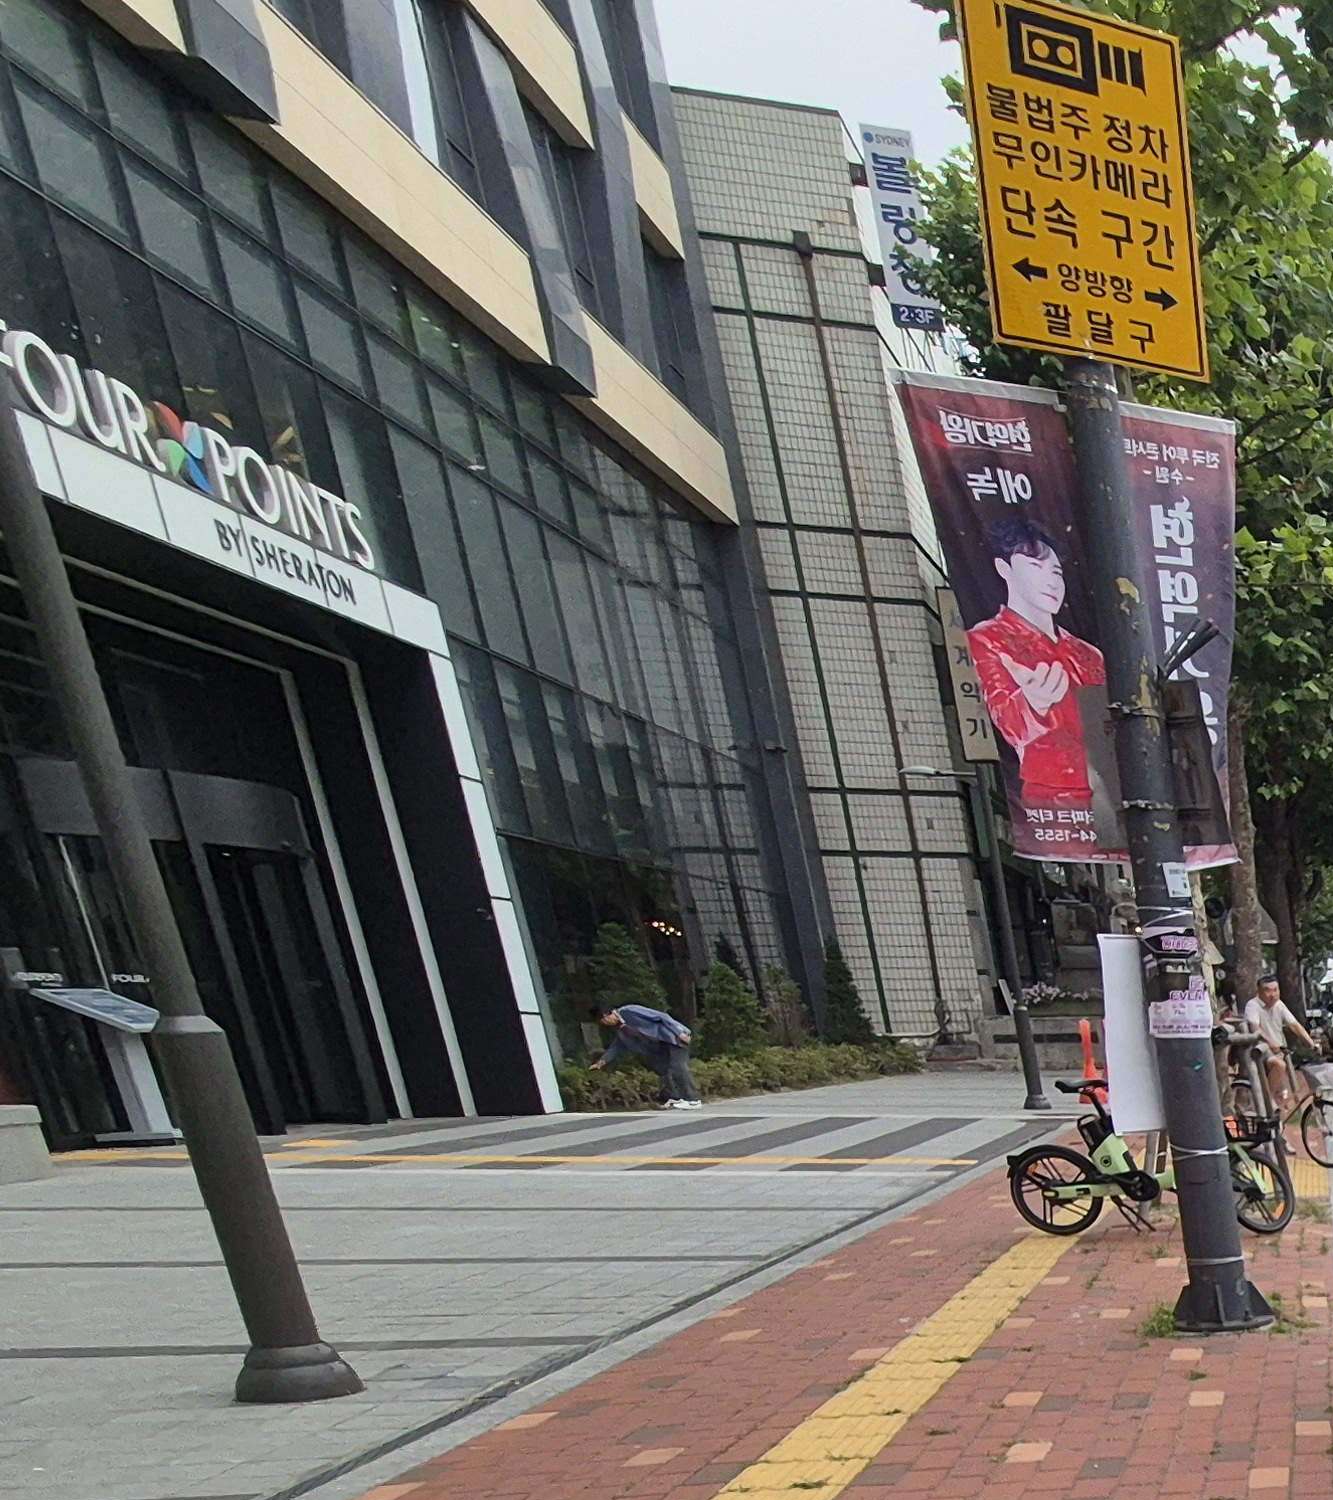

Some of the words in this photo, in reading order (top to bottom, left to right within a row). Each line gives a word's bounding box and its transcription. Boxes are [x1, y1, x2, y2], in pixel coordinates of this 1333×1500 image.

[874, 133, 911, 148] SYDNEY
[993, 131, 1173, 209] 무인카메라
[1000, 185, 1079, 249] 단속
[1101, 209, 1175, 271] 구간
[1057, 263, 1134, 304] 양방향
[202, 428, 376, 571] POINTS
[213, 519, 246, 554] BY
[253, 541, 357, 607] SHERATON
